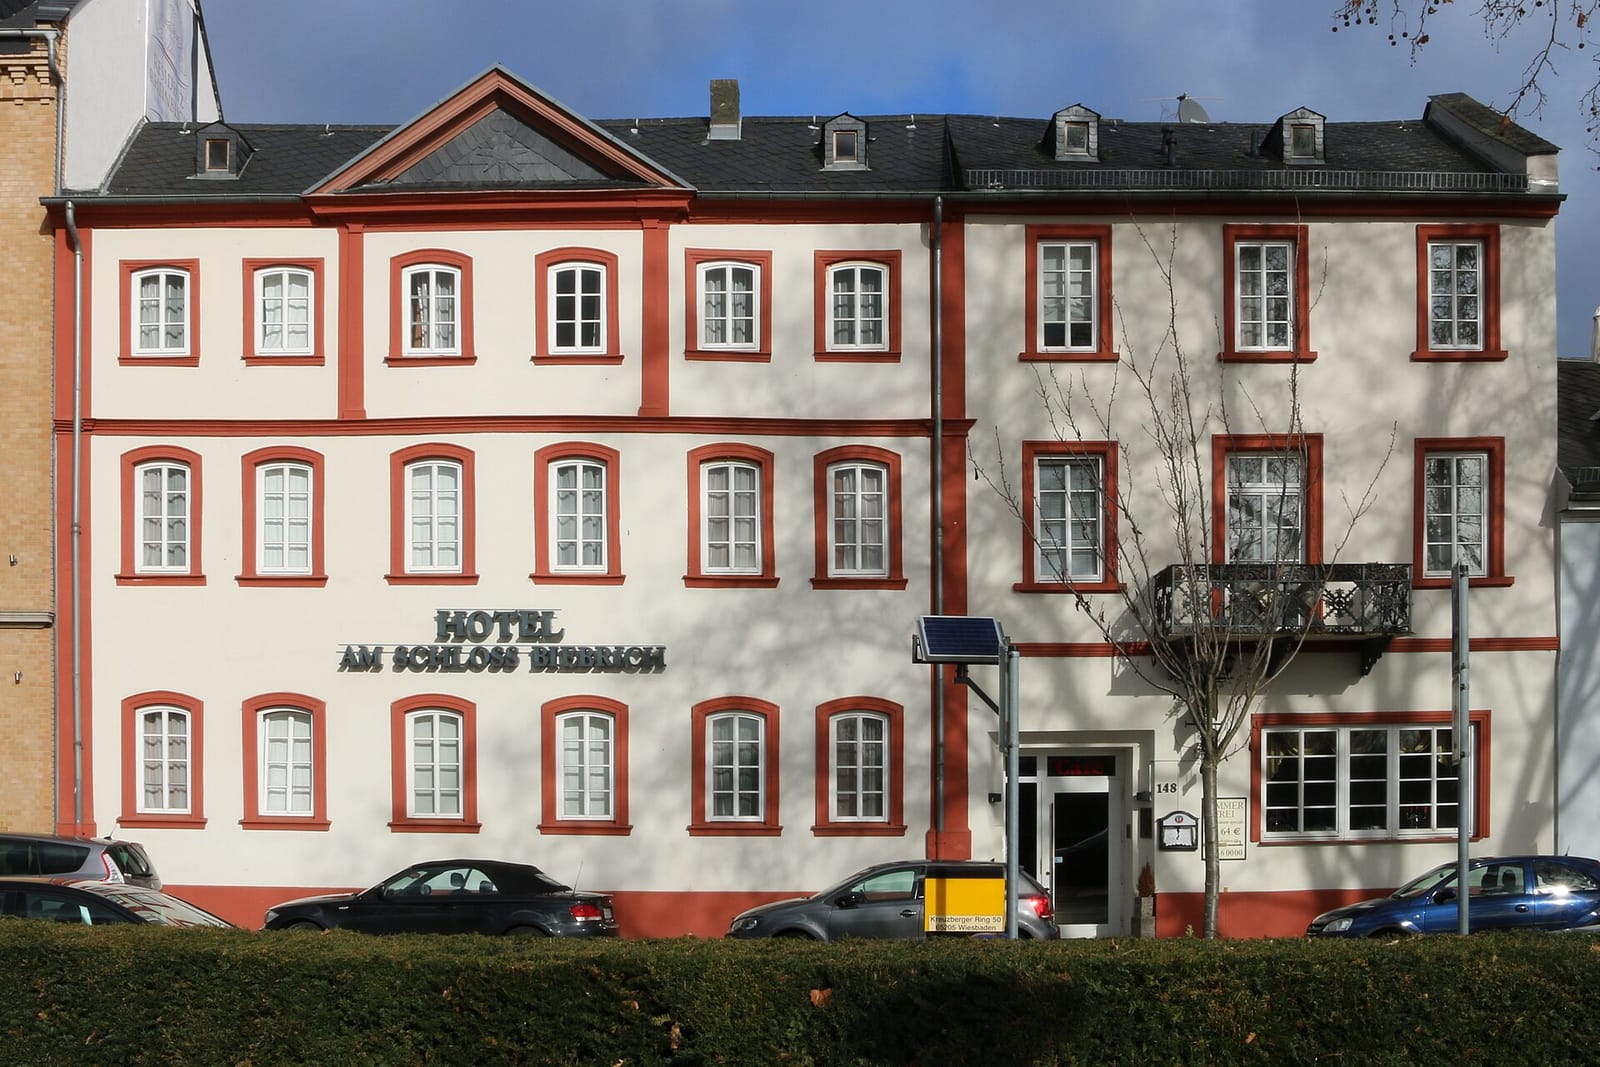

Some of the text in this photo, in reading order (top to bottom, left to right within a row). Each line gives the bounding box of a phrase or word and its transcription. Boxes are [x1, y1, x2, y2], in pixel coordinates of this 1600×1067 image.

[435, 610, 565, 643] HOTEL
[337, 645, 667, 673] AM SCHLOSS BIEBRICH
[1156, 782, 1177, 794] 148
[1217, 810, 1235, 818] REI
[1233, 827, 1241, 836] €
[930, 916, 973, 924] Kreuzberger
[975, 916, 990, 924] Ring
